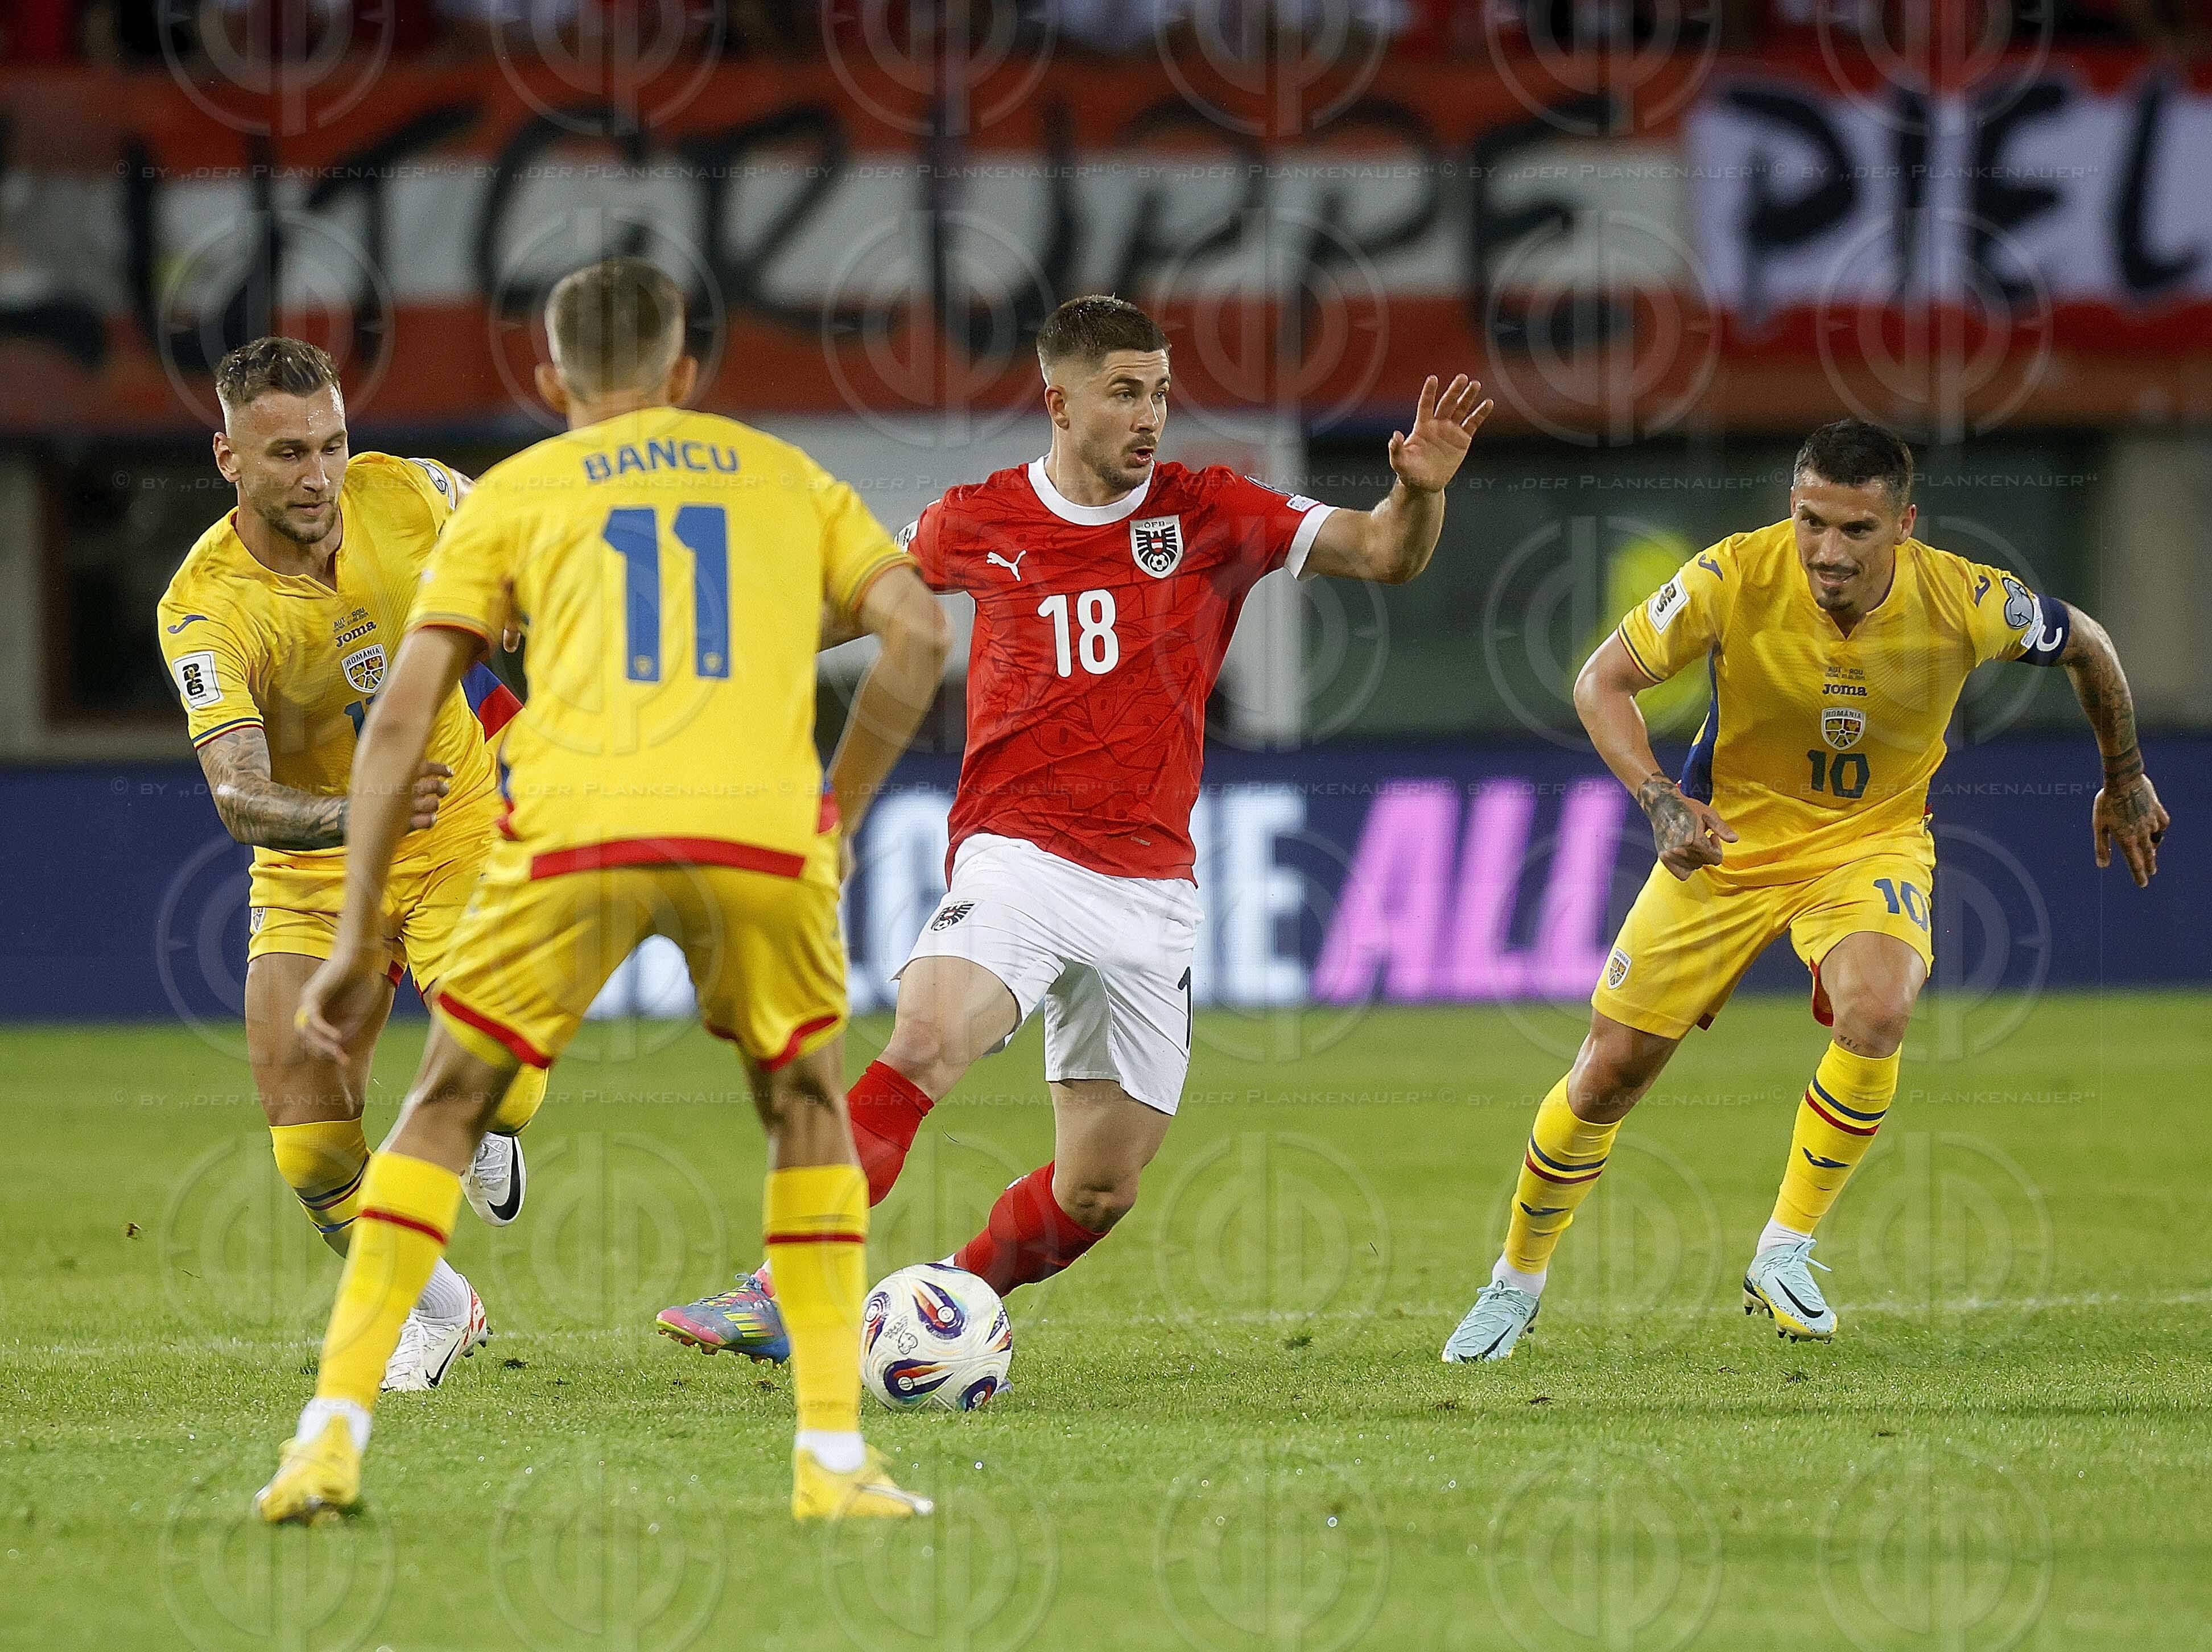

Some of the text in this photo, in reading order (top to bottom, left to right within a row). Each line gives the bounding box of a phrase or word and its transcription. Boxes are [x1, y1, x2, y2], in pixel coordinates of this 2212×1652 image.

[583, 439, 738, 482] BANCU
[602, 505, 729, 682] 11
[1037, 589, 1120, 678] 18
[1807, 749, 1871, 799] 10
[1310, 777, 1628, 1005] ALL
[1872, 878, 1928, 932] 10
